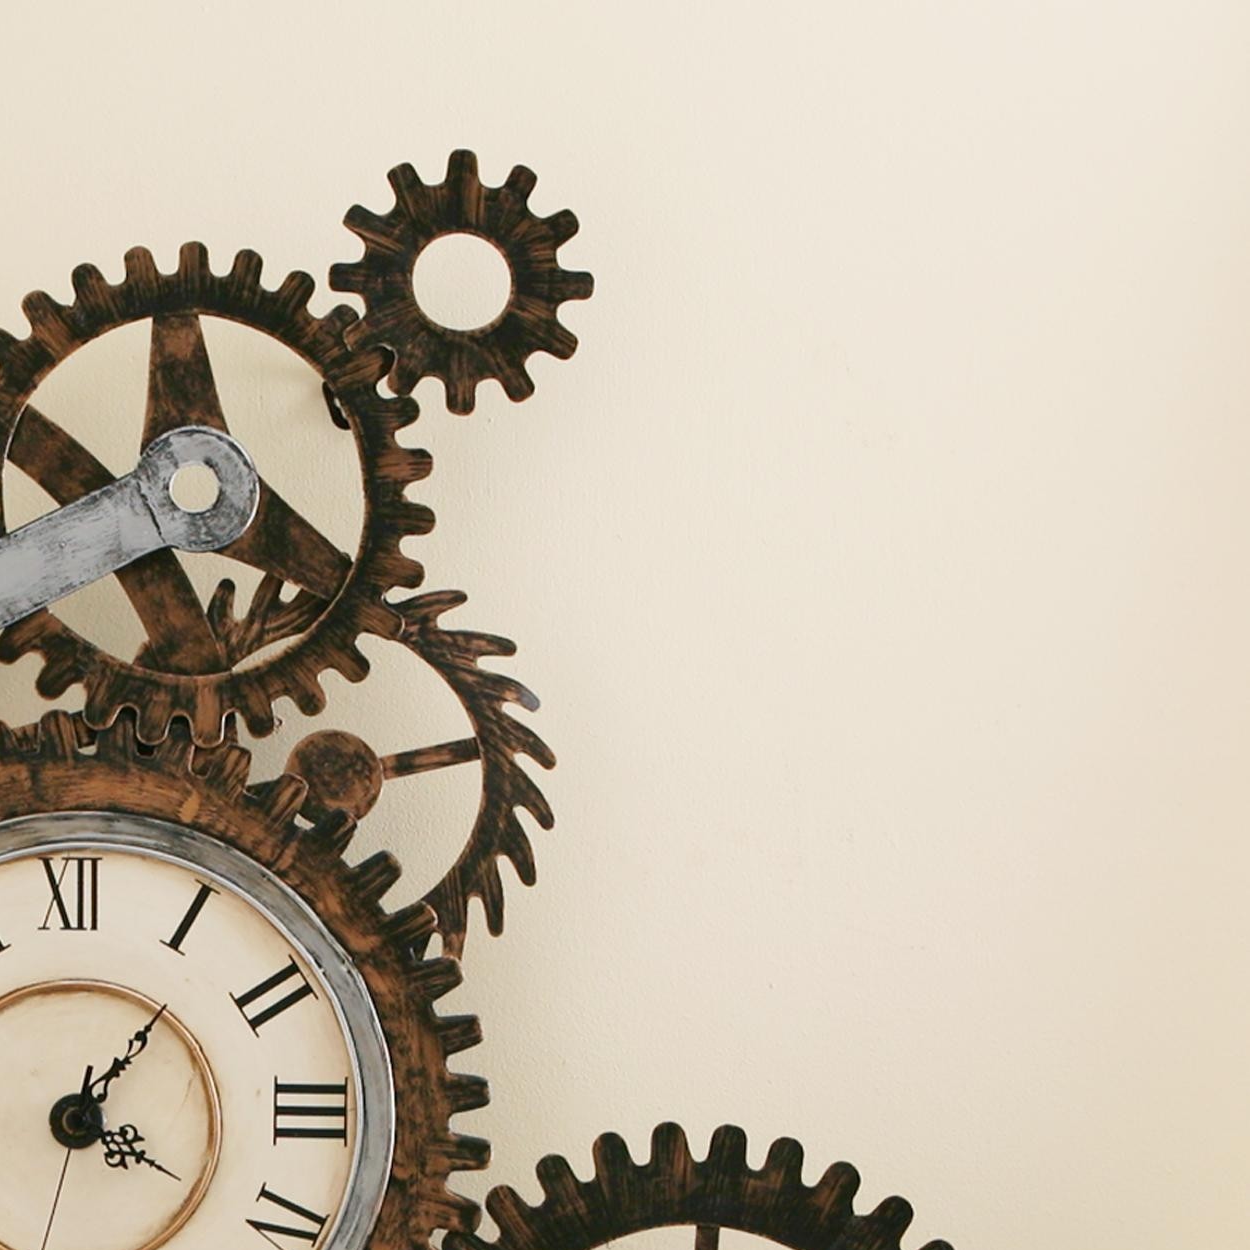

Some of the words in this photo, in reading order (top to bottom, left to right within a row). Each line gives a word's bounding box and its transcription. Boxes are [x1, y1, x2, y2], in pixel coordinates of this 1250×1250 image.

[38, 856, 103, 931] XII
[159, 878, 222, 956] I
[229, 954, 319, 1038] II
[272, 1075, 349, 1147] III
